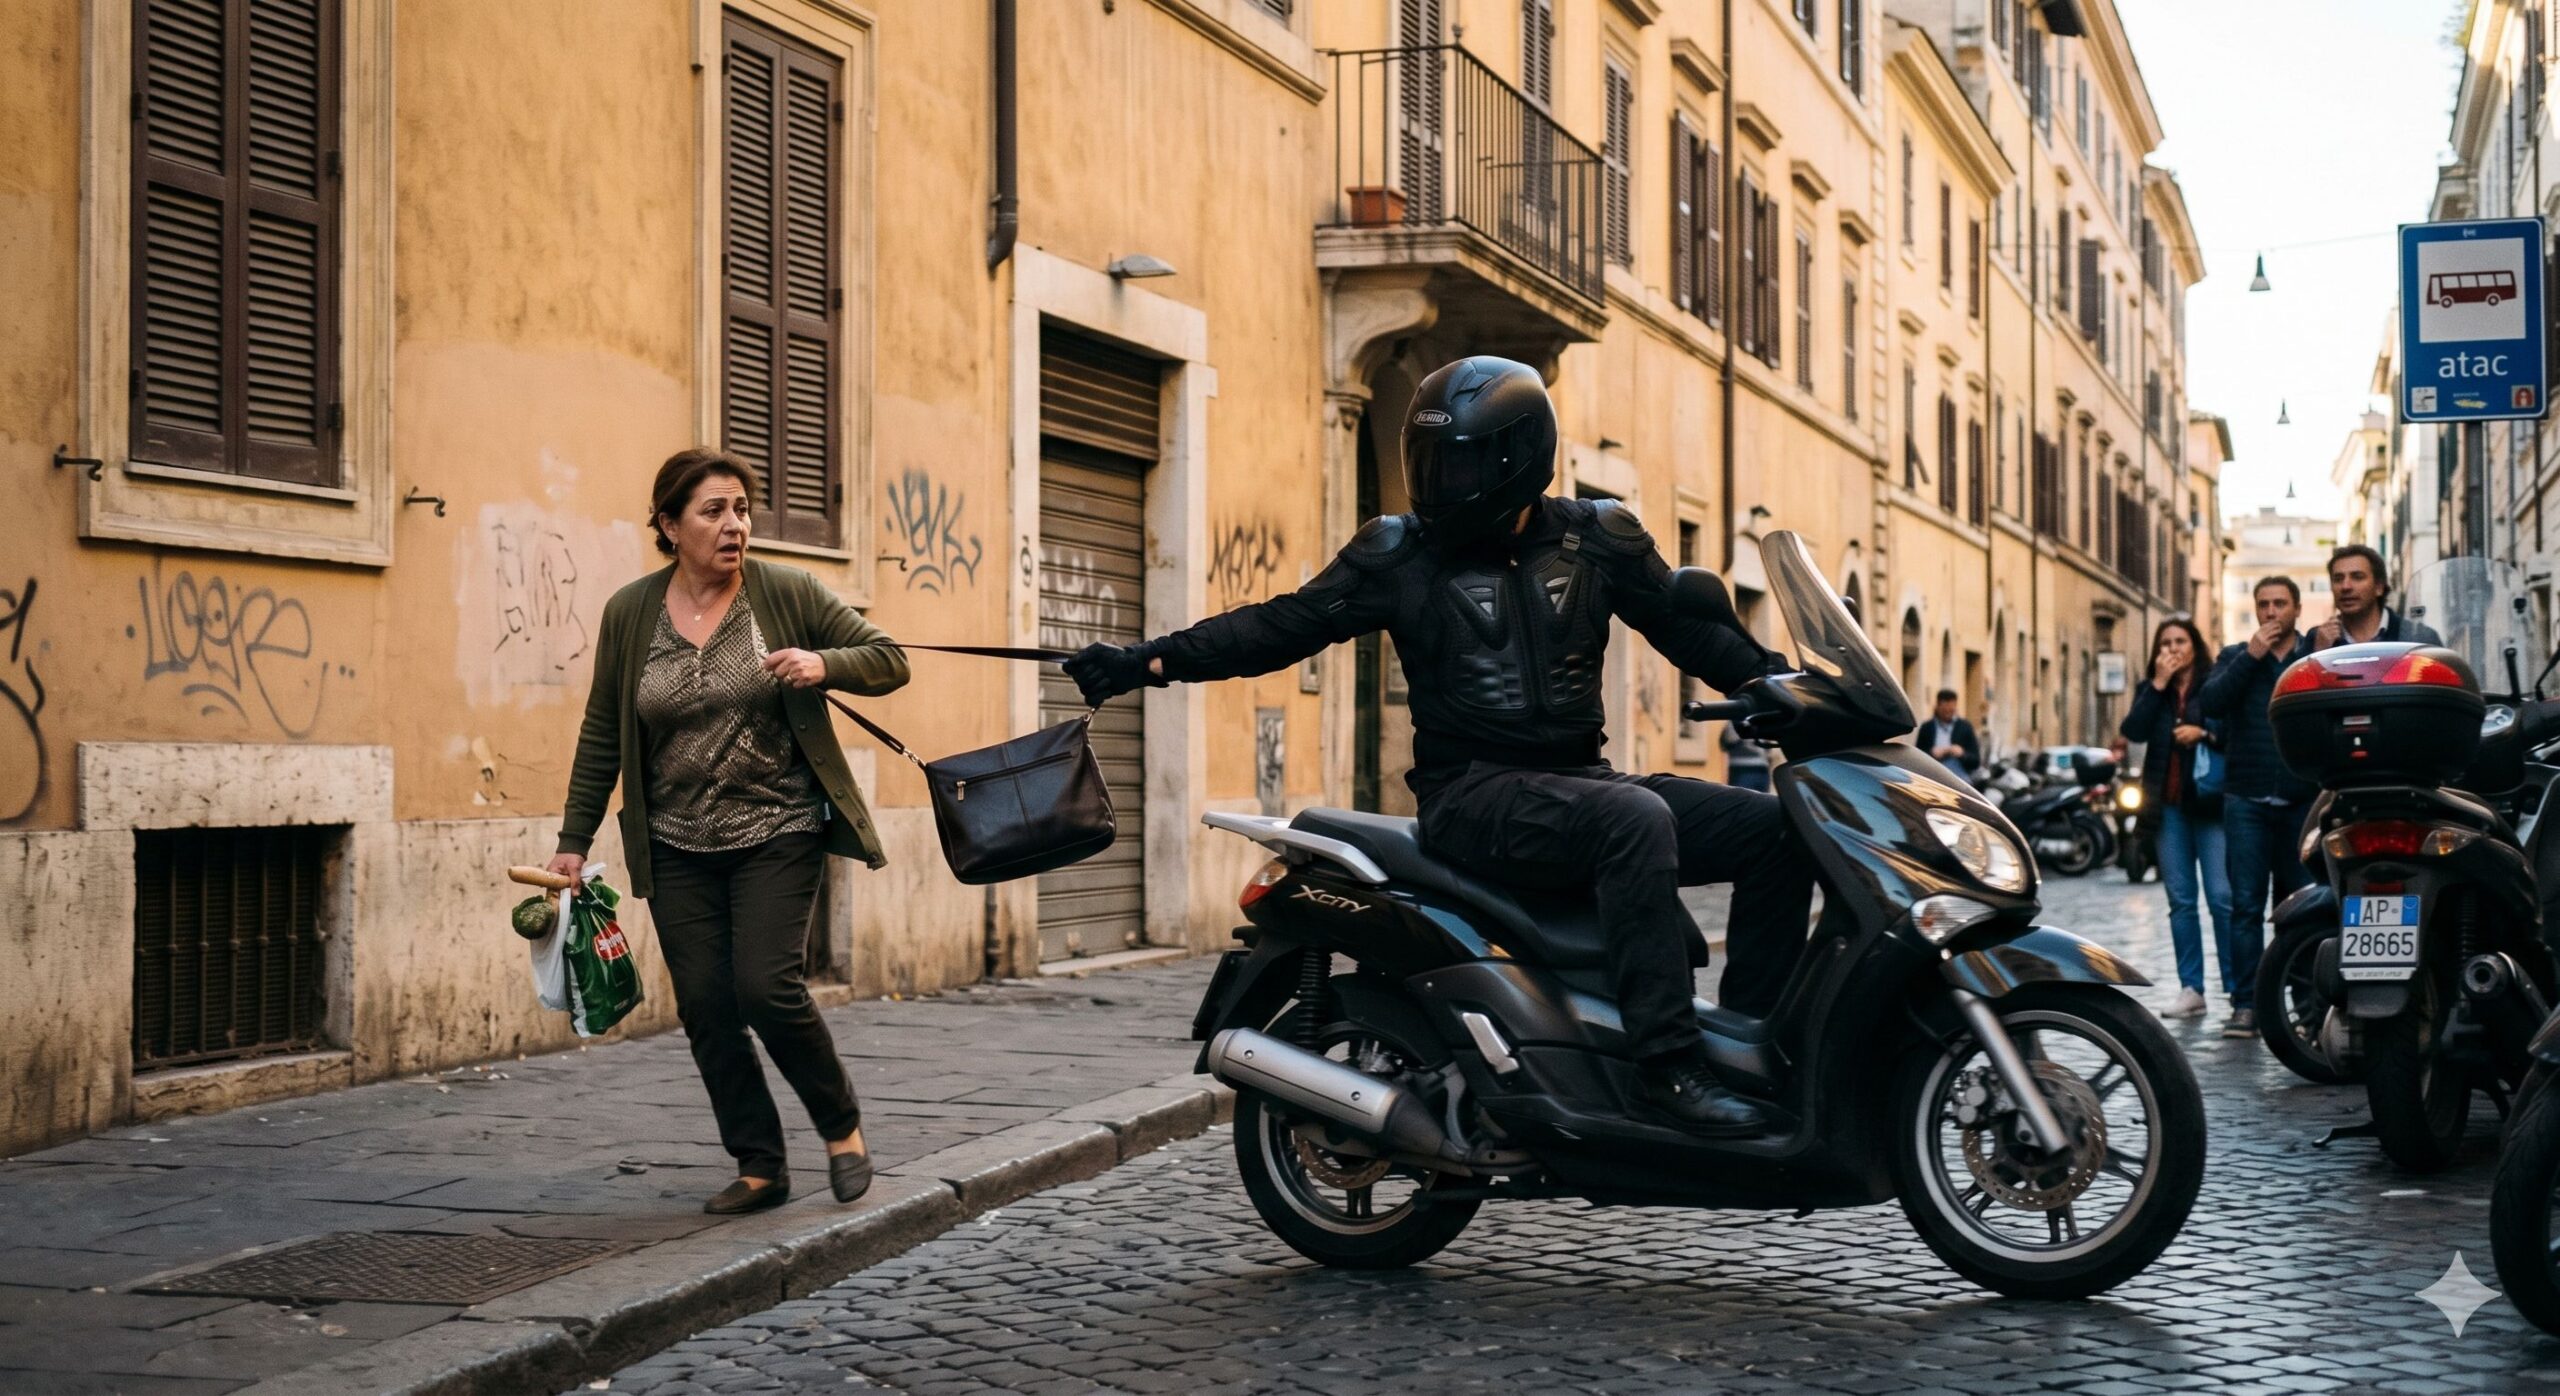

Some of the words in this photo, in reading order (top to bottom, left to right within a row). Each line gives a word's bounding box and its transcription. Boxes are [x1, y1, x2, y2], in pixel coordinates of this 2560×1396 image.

[2438, 351, 2509, 378] atac
[2362, 899, 2389, 923] AP
[2344, 932, 2414, 957] 28665
